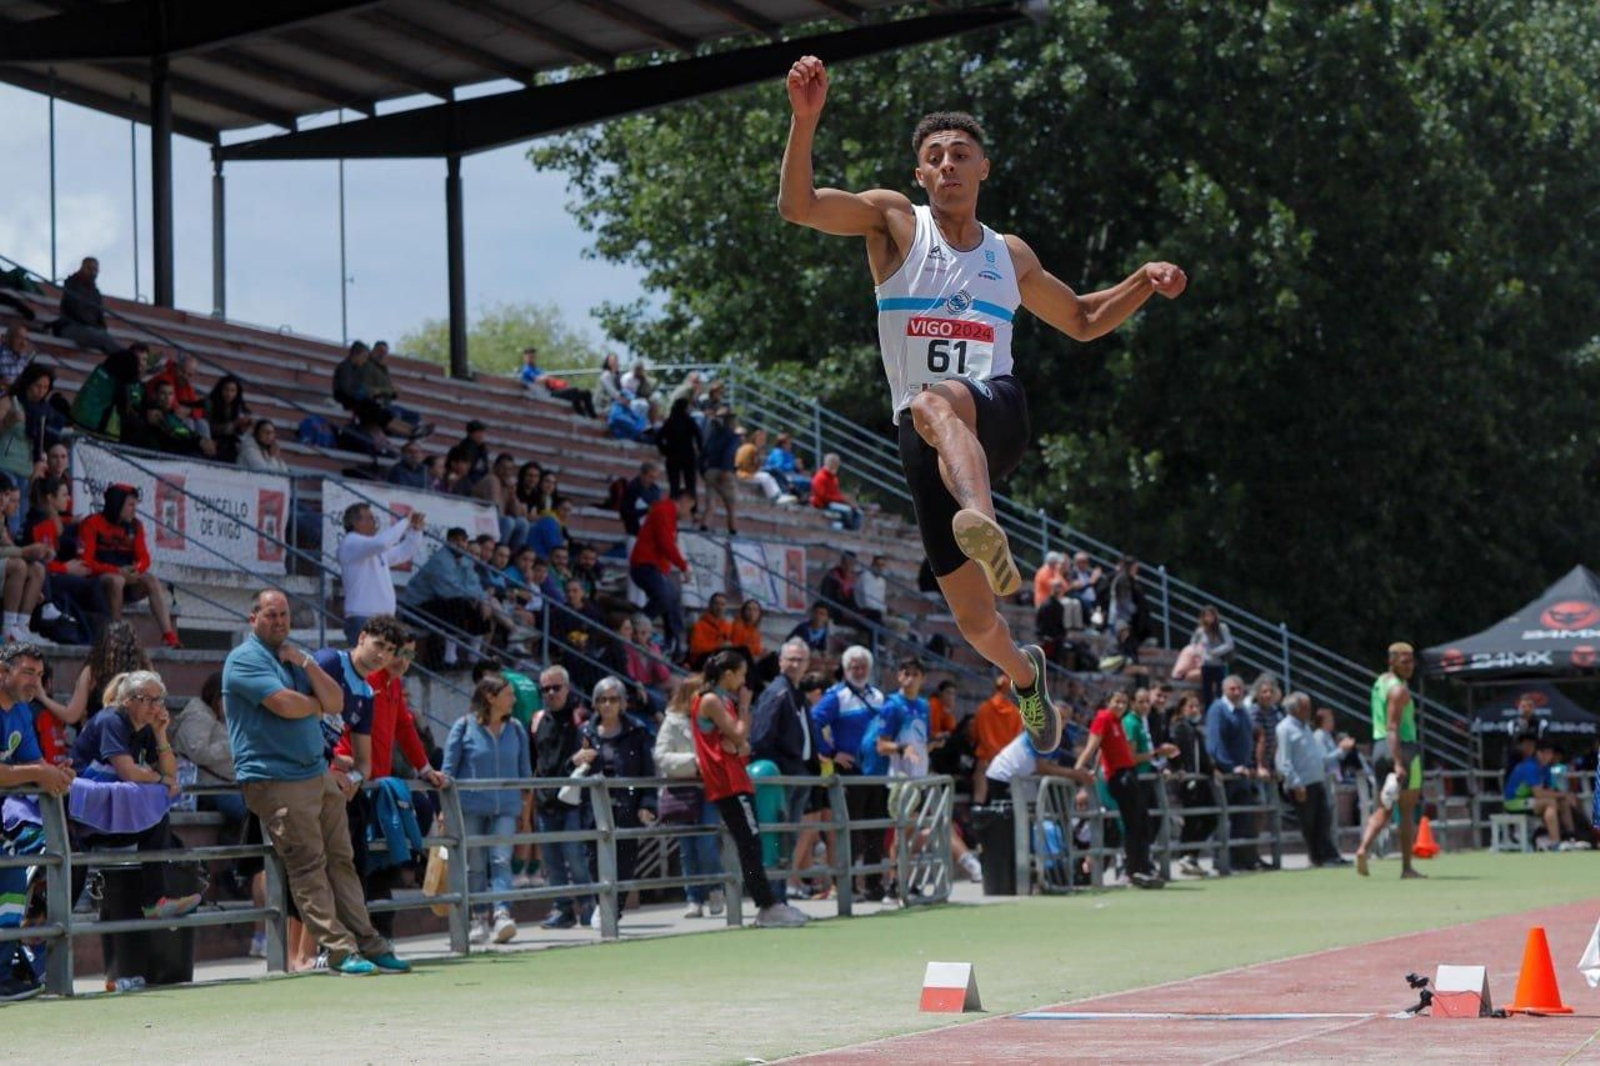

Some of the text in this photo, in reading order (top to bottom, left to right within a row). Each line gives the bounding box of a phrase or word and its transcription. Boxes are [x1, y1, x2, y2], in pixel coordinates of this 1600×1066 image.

[927, 339, 967, 374] 61
[194, 496, 248, 519] CONCELLO
[201, 517, 241, 541] DE VIGO
[1470, 650, 1553, 669] 24MX
